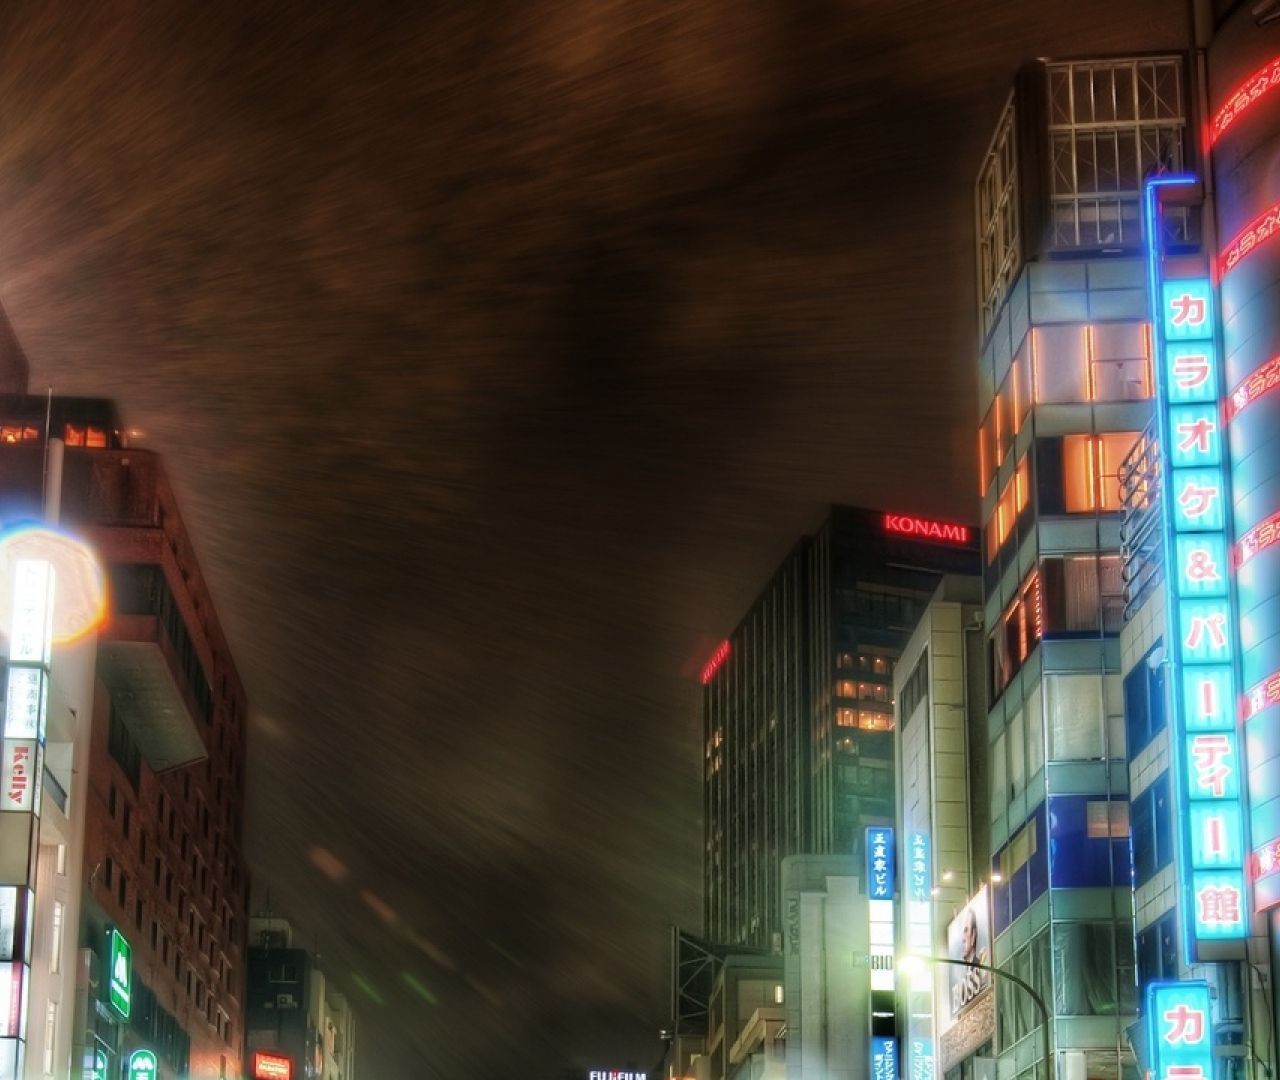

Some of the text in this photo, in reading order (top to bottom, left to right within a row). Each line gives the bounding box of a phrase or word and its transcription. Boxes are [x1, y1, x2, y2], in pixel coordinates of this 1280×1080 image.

[885, 514, 968, 543] KONAMI
[1171, 293, 1241, 924] カラオケ&パーティー館
[951, 967, 988, 1014] BOSS
